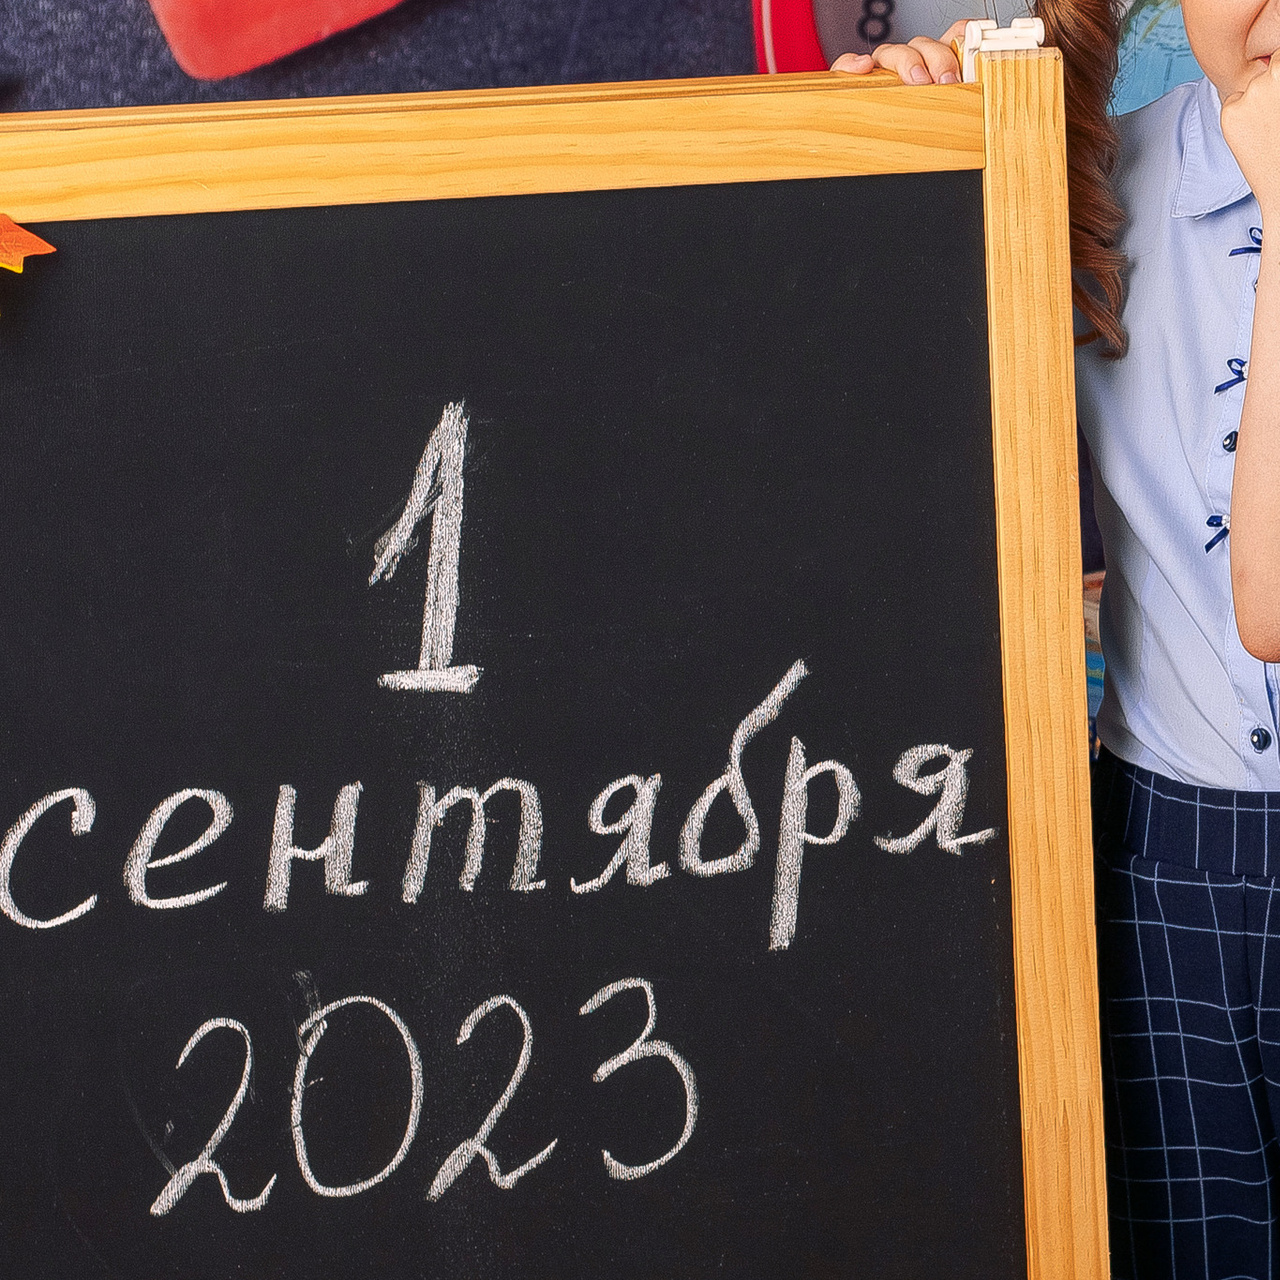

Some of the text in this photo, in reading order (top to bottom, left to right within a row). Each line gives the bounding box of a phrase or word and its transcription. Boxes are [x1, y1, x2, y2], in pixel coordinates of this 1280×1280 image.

[368, 401, 484, 694] 1
[0, 659, 997, 951] сентября
[150, 977, 699, 1217] 2023
